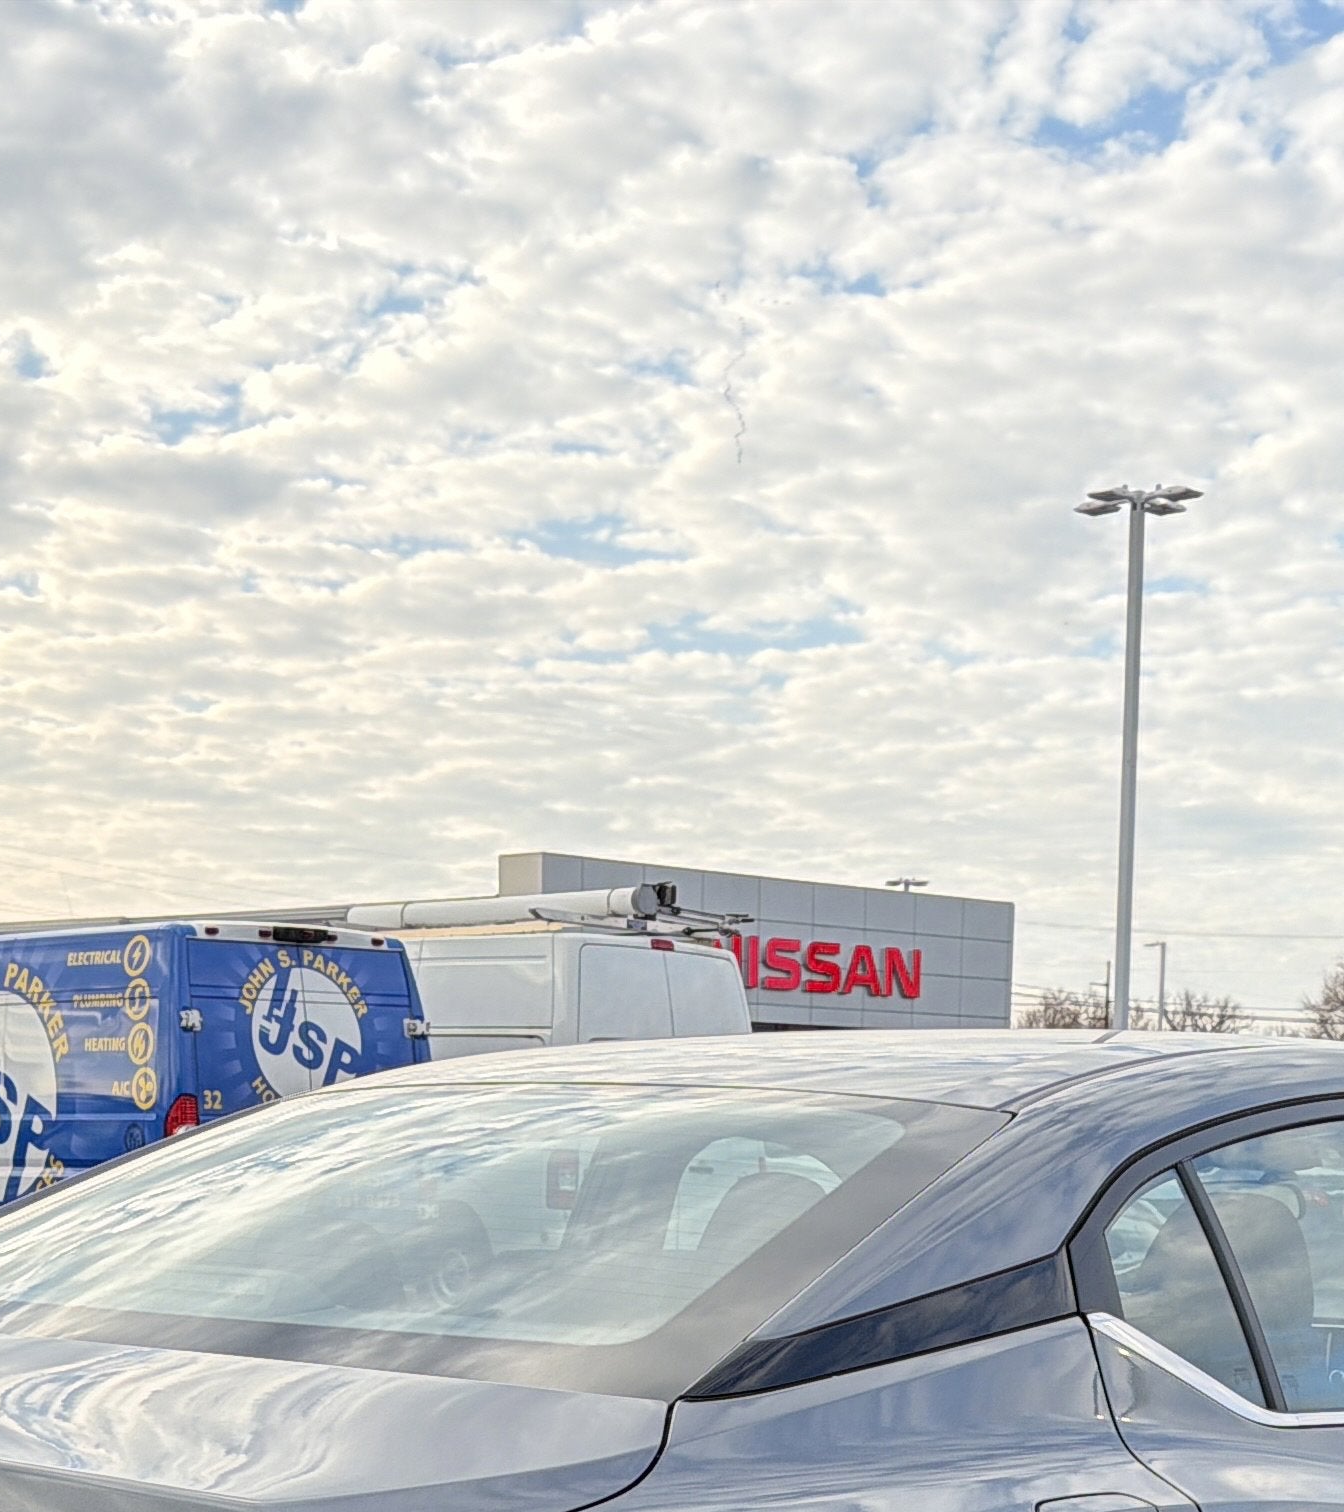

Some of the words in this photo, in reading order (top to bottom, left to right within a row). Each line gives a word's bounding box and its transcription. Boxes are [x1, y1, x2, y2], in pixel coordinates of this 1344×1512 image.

[66, 950, 122, 967] ELECTRICAL
[239, 957, 276, 1015] JOHN
[277, 949, 296, 968] S.
[303, 949, 369, 1018] PARKER
[72, 992, 125, 1009] PLUMBING
[4, 961, 70, 1063] PARKER
[84, 1037, 126, 1052] HEATING
[112, 1080, 131, 1097] A/C
[203, 1089, 223, 1110] 32
